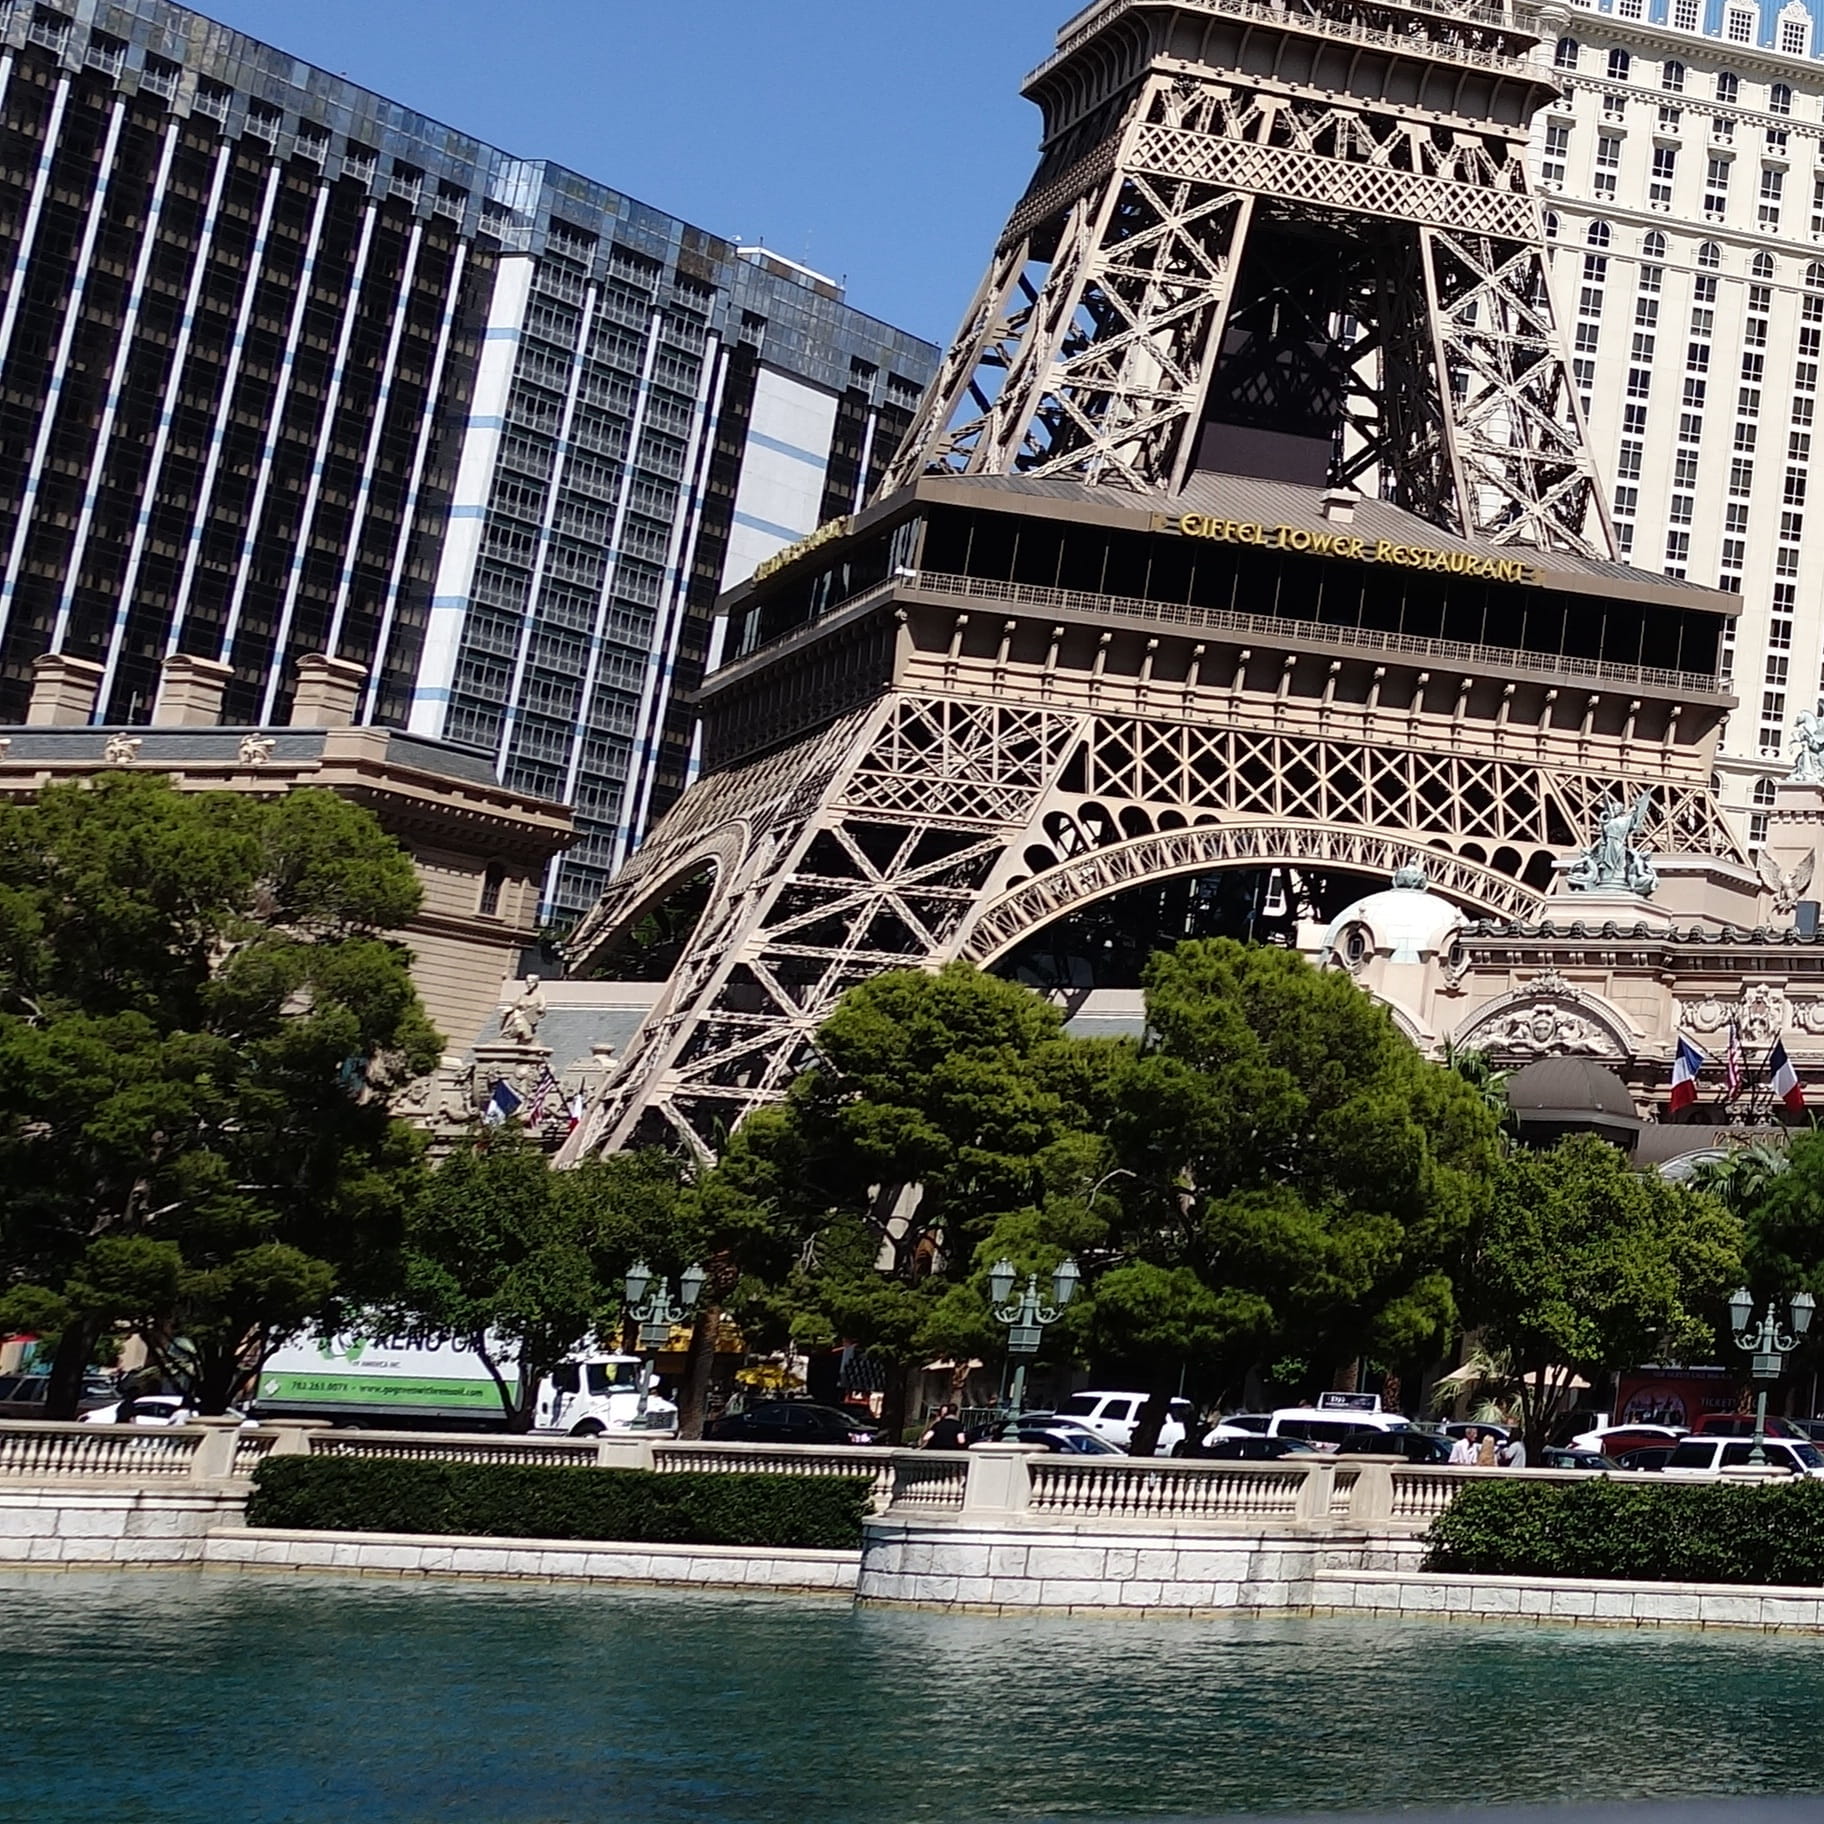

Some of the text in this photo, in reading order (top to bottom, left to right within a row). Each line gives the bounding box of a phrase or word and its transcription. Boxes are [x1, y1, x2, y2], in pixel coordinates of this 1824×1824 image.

[1180, 512, 1529, 582] EIFFEL TOWER RESTAURANT
